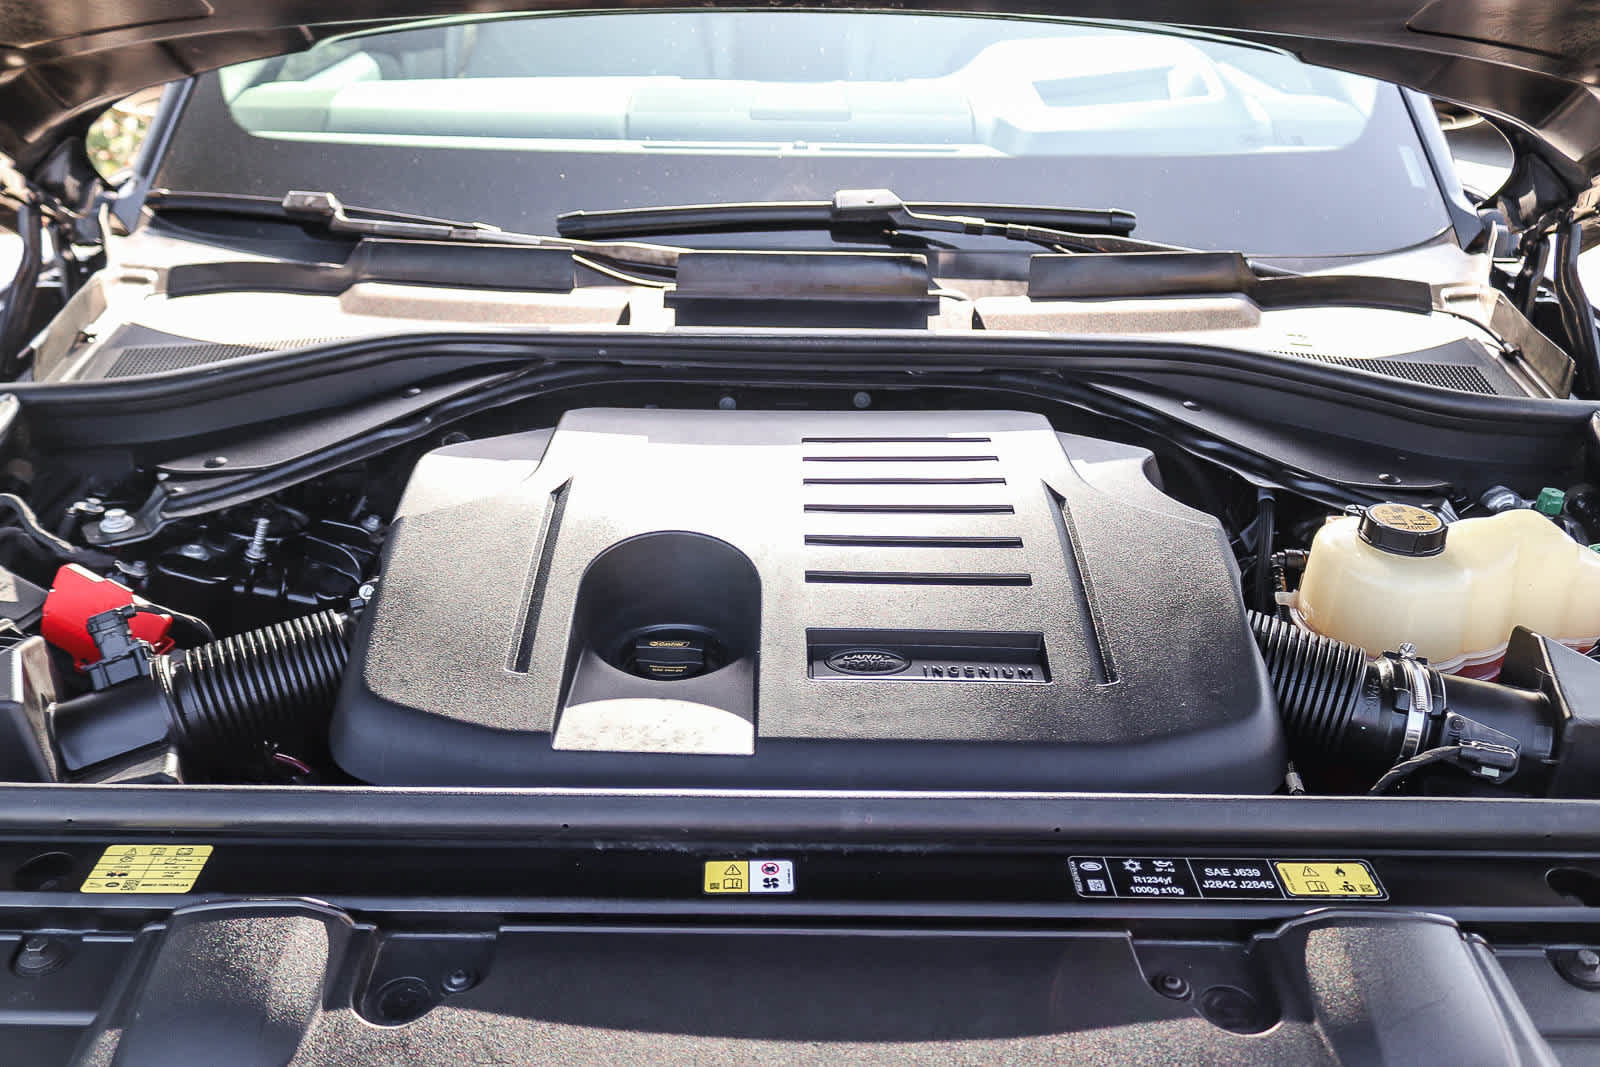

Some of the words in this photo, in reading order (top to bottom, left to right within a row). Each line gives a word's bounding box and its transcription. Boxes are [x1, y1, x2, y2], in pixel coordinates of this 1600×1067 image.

[922, 664, 1035, 680] INGENIUM
[1204, 868, 1231, 877] SAE
[1232, 868, 1261, 877] J639
[1133, 876, 1172, 885] R1234yf
[1202, 880, 1237, 889] J2842
[1239, 880, 1275, 889] J2845
[1130, 886, 1160, 895] 1000g
[1161, 886, 1185, 895] ±10g
